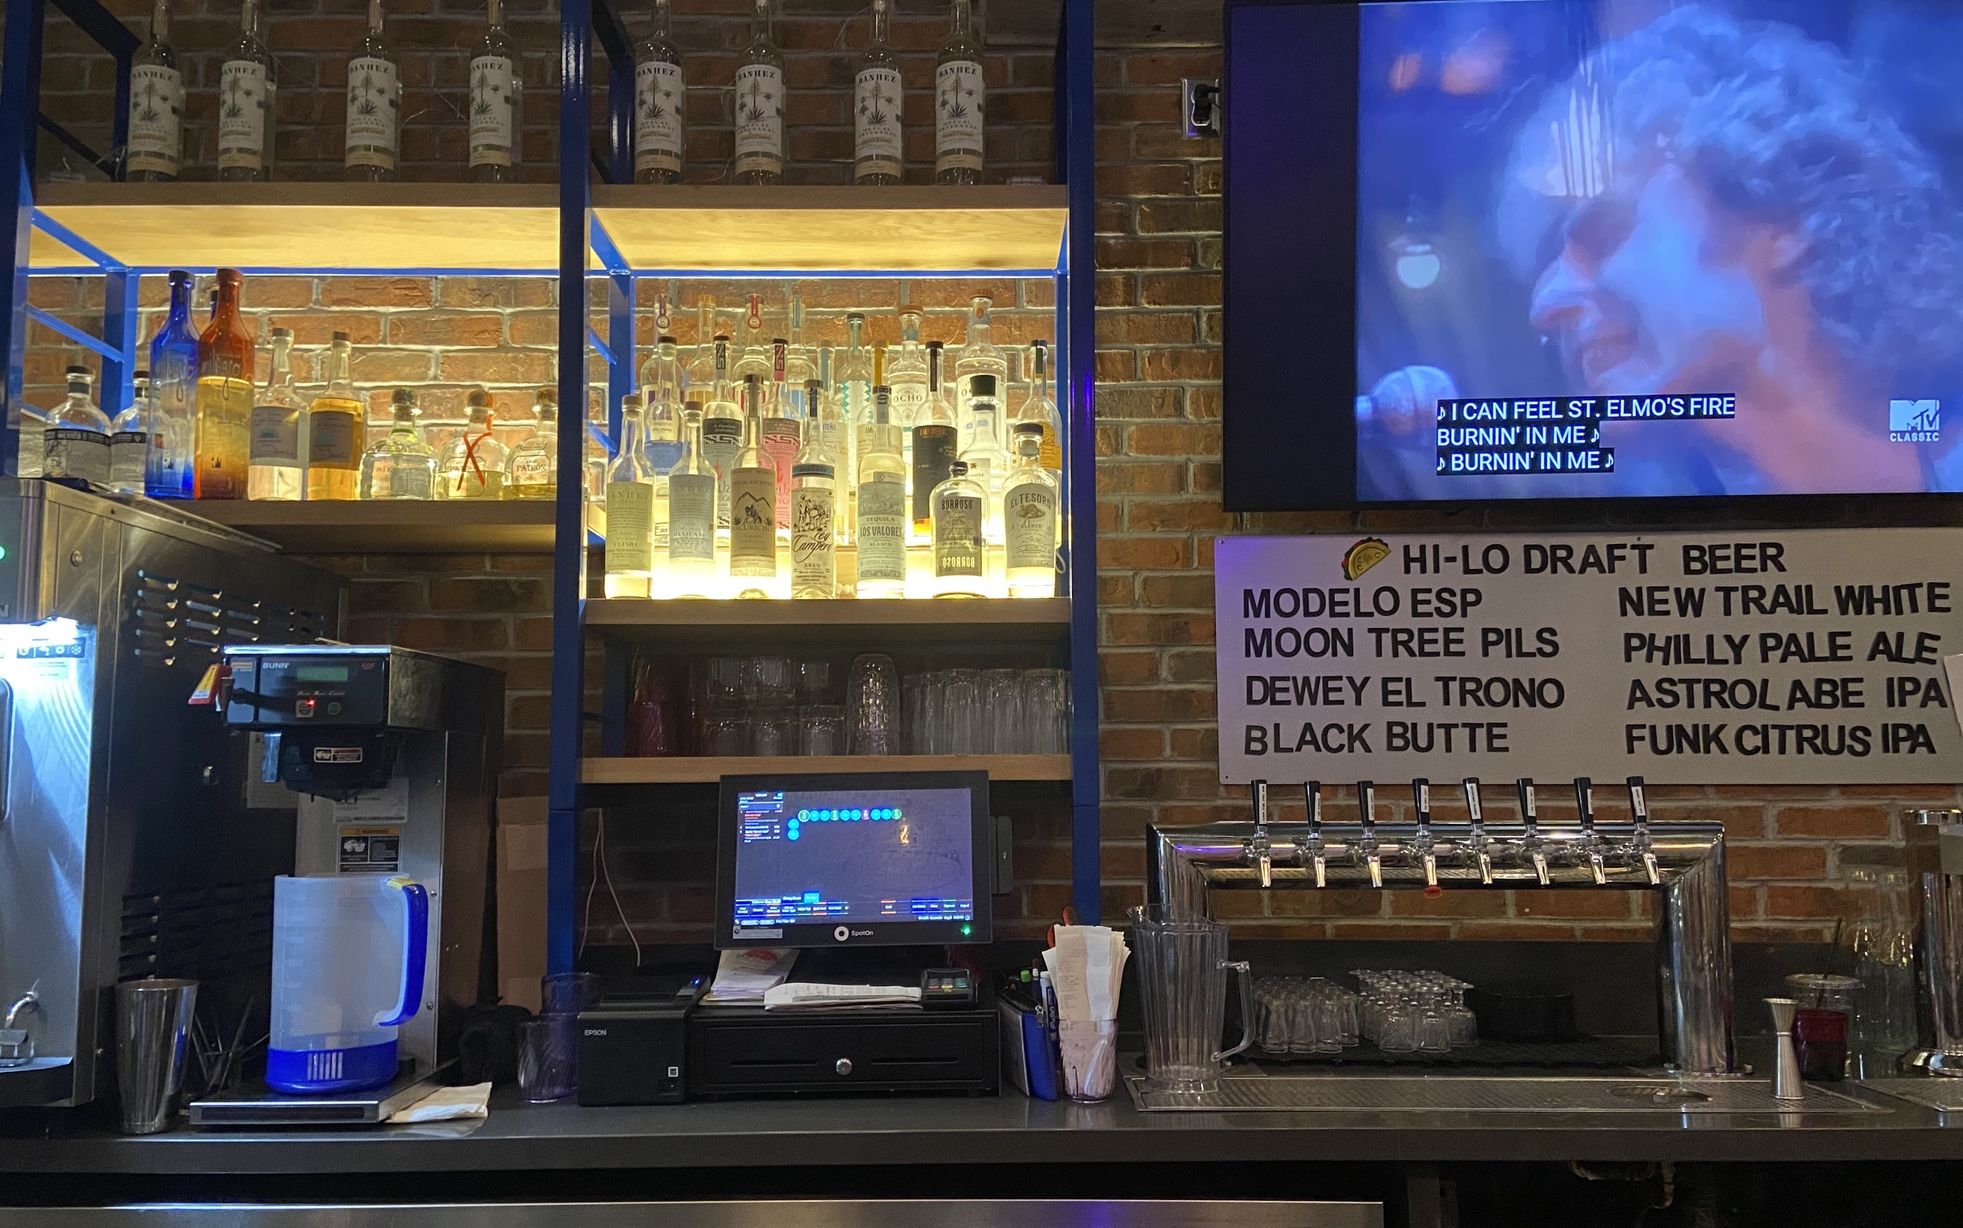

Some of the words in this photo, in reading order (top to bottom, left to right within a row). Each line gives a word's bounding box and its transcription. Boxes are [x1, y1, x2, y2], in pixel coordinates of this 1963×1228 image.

[1463, 398, 1508, 419] CAN
[1514, 398, 1562, 418] FEEL
[1568, 397, 1600, 418] ST.
[1607, 395, 1684, 417] ELMO'S
[1690, 394, 1735, 416] FIRE
[1890, 400, 1940, 431] MTV
[1437, 428, 1521, 447] BURNIN'
[1526, 428, 1548, 446] IN
[1553, 427, 1585, 446] ME
[1890, 433, 1940, 442] CLASSIC
[1451, 453, 1535, 473] BURNIN'
[1540, 453, 1562, 472] IN
[1567, 452, 1600, 472] ME
[942, 499, 973, 510] BORROSO
[1019, 493, 1051, 509] TESORO
[1403, 544, 1509, 575] HI-LO
[1523, 543, 1654, 575] DRAFT
[1683, 542, 1787, 575] BEER
[1244, 586, 1400, 618] MODELO
[1411, 587, 1482, 618] ESP
[1619, 586, 1706, 617] NEW
[1714, 584, 1828, 616] TRAIL
[1834, 582, 1951, 616] WHITE
[1245, 627, 1353, 657] MOON
[1367, 627, 1465, 658] TREE
[1481, 627, 1559, 658] PILS
[1624, 633, 1750, 665] PHILLY
[1759, 631, 1853, 663] PALE
[1867, 631, 1944, 665] ALE
[1247, 676, 1371, 706] DEWEY
[1381, 677, 1426, 707] EL
[1434, 676, 1564, 708] TRONO
[1886, 674, 1950, 708] IPA
[1245, 723, 1372, 755] BLACK
[1387, 721, 1509, 753] BUTTE
[1625, 724, 1729, 755] FUNK
[1734, 724, 1872, 757] CITRUS
[1881, 723, 1936, 754] IPA
[851, 929, 875, 937] SpotOn
